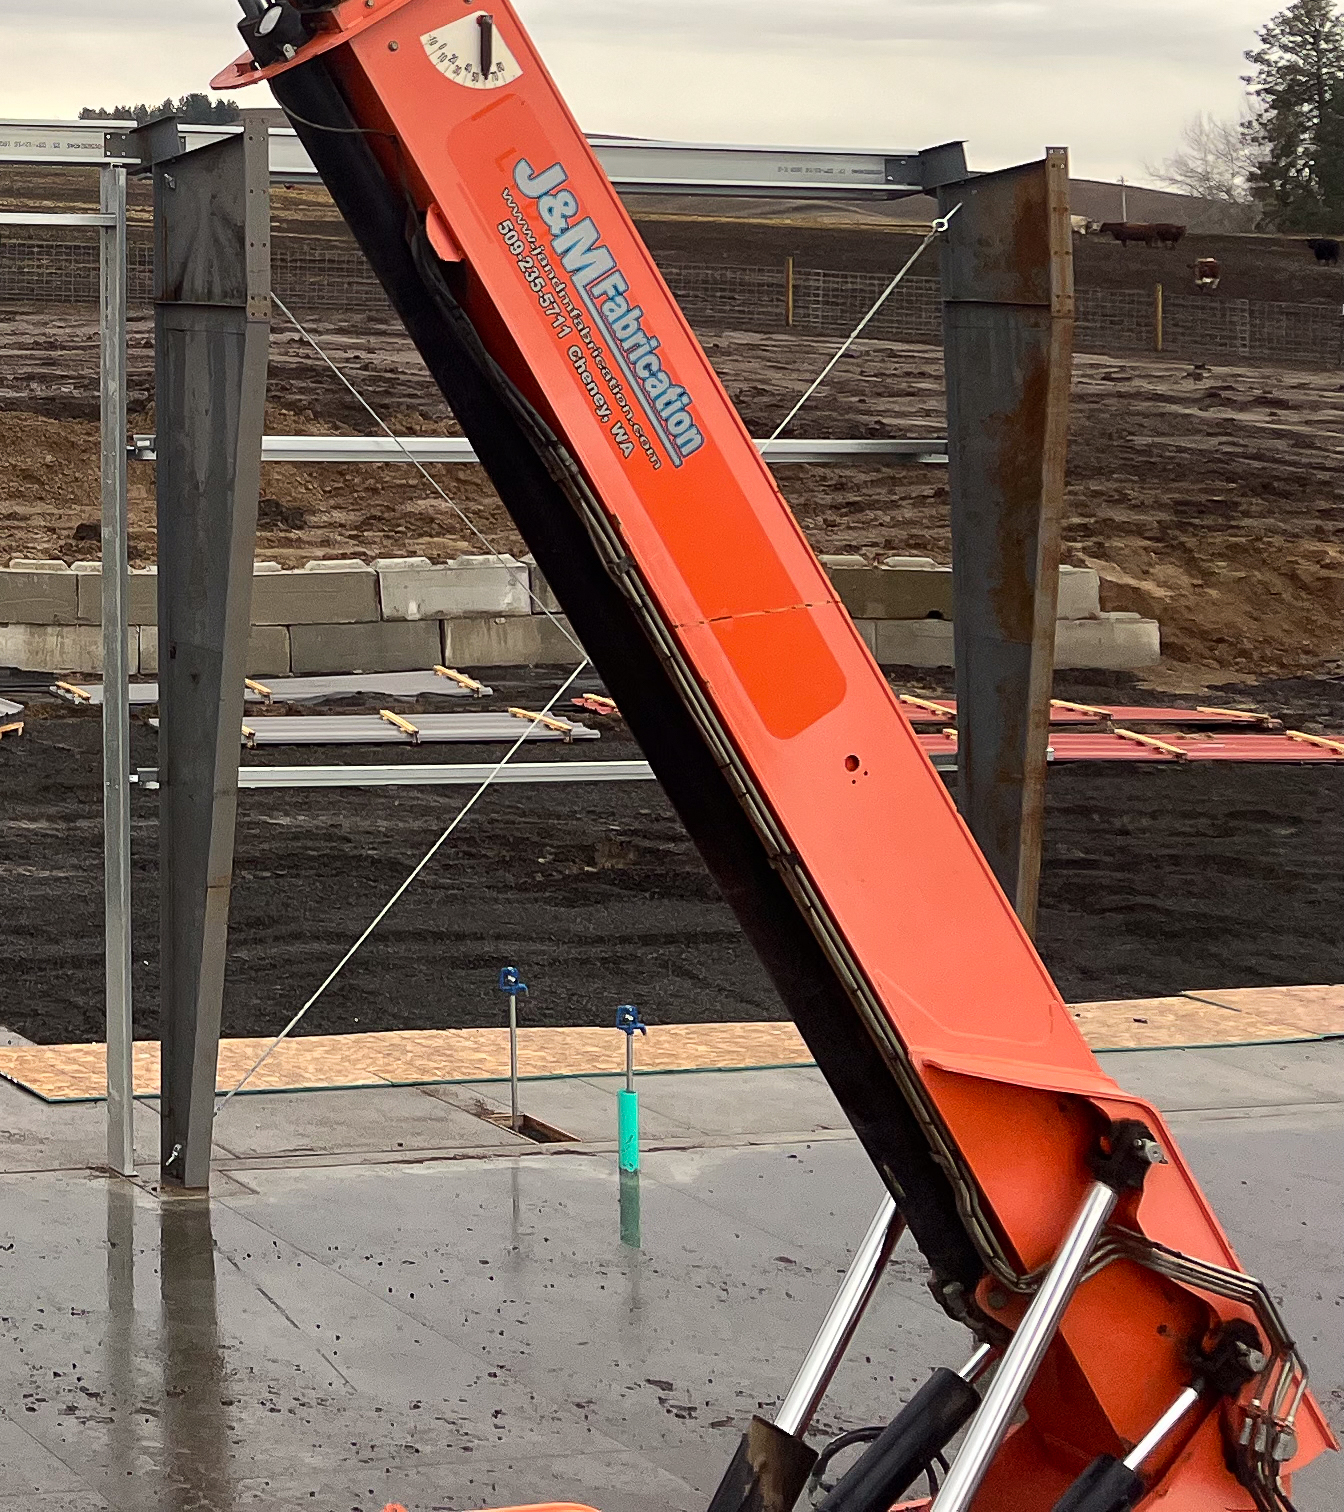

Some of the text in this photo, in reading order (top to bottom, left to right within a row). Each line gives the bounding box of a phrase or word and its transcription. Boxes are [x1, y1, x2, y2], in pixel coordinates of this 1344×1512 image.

[497, 219, 573, 338] 509-235-5711
[567, 345, 612, 424] Cheney,
[610, 420, 635, 459] WA
[502, 187, 662, 470] www.jandmfabrication.com
[513, 157, 705, 458] J&M Fabrication
